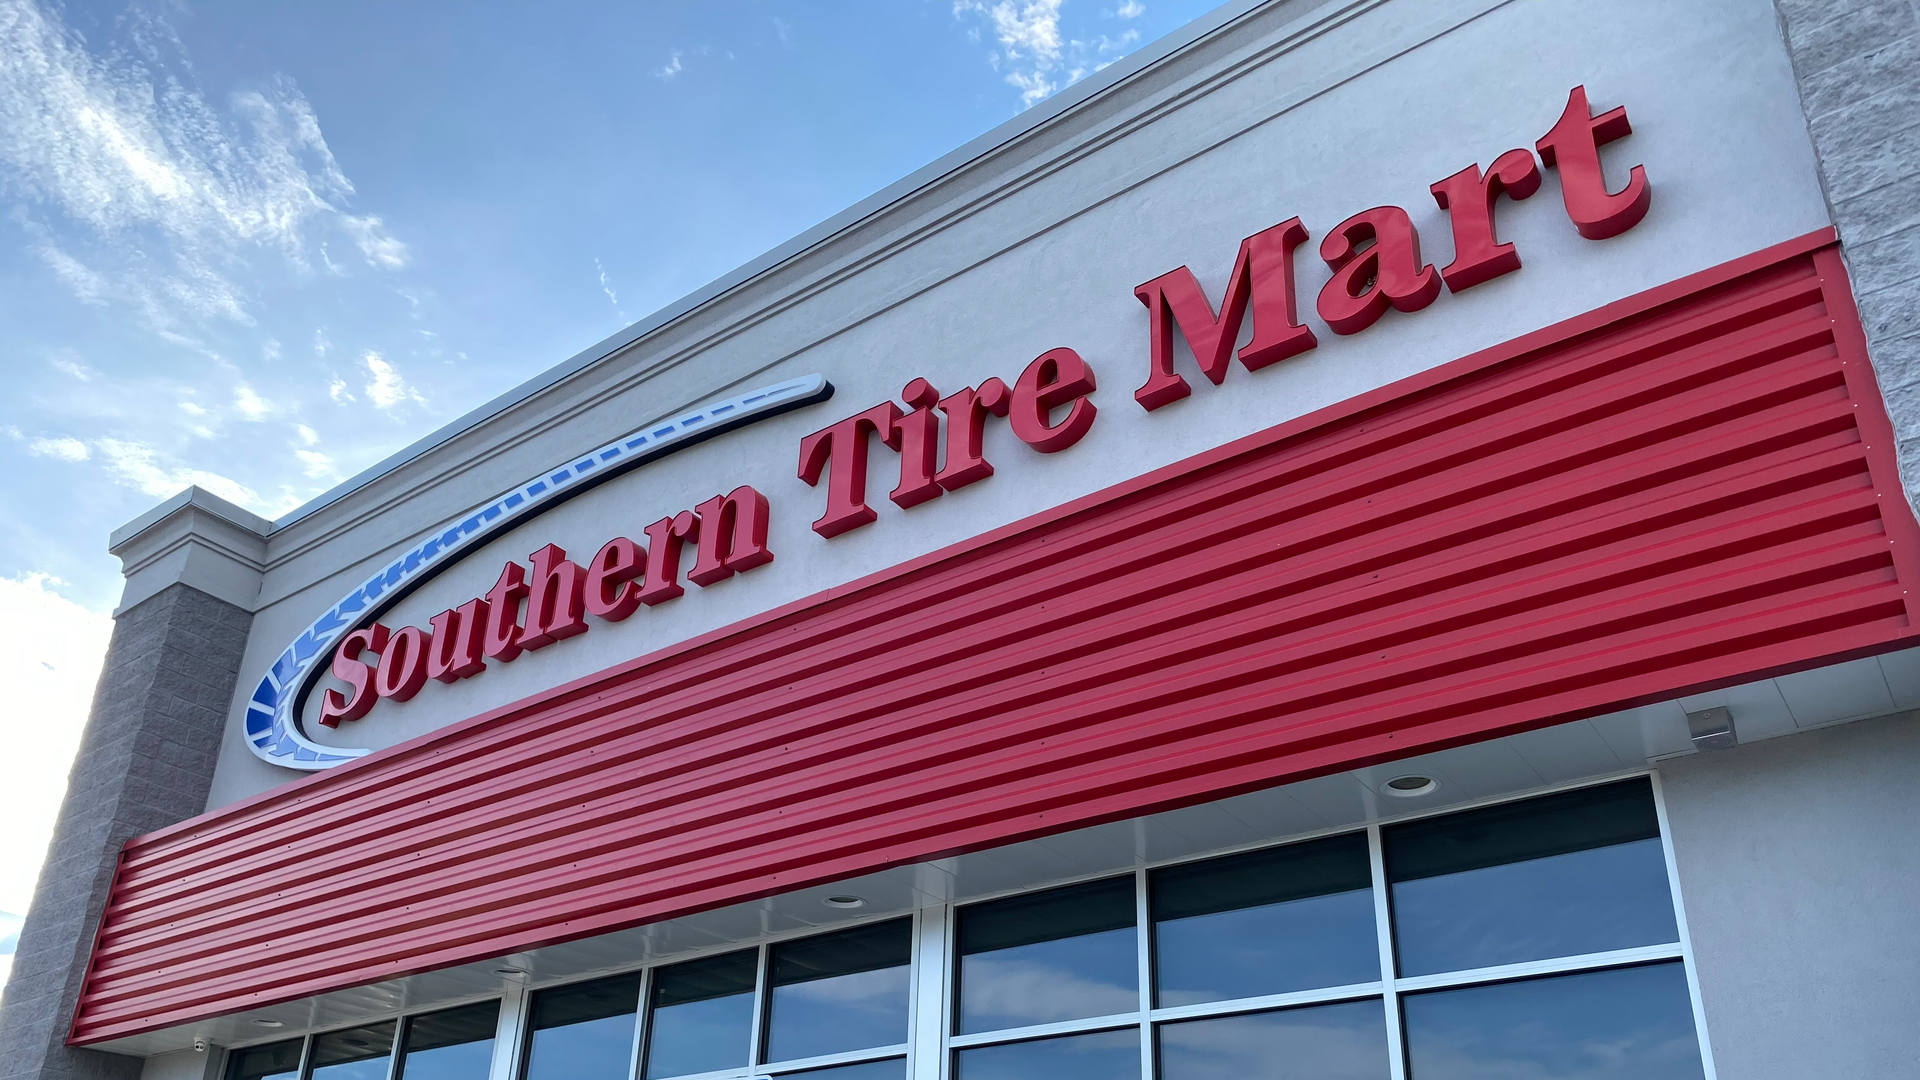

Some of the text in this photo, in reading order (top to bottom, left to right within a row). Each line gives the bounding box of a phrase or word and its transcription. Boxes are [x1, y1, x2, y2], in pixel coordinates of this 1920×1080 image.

[319, 84, 1652, 728] Southern Tire Mart
